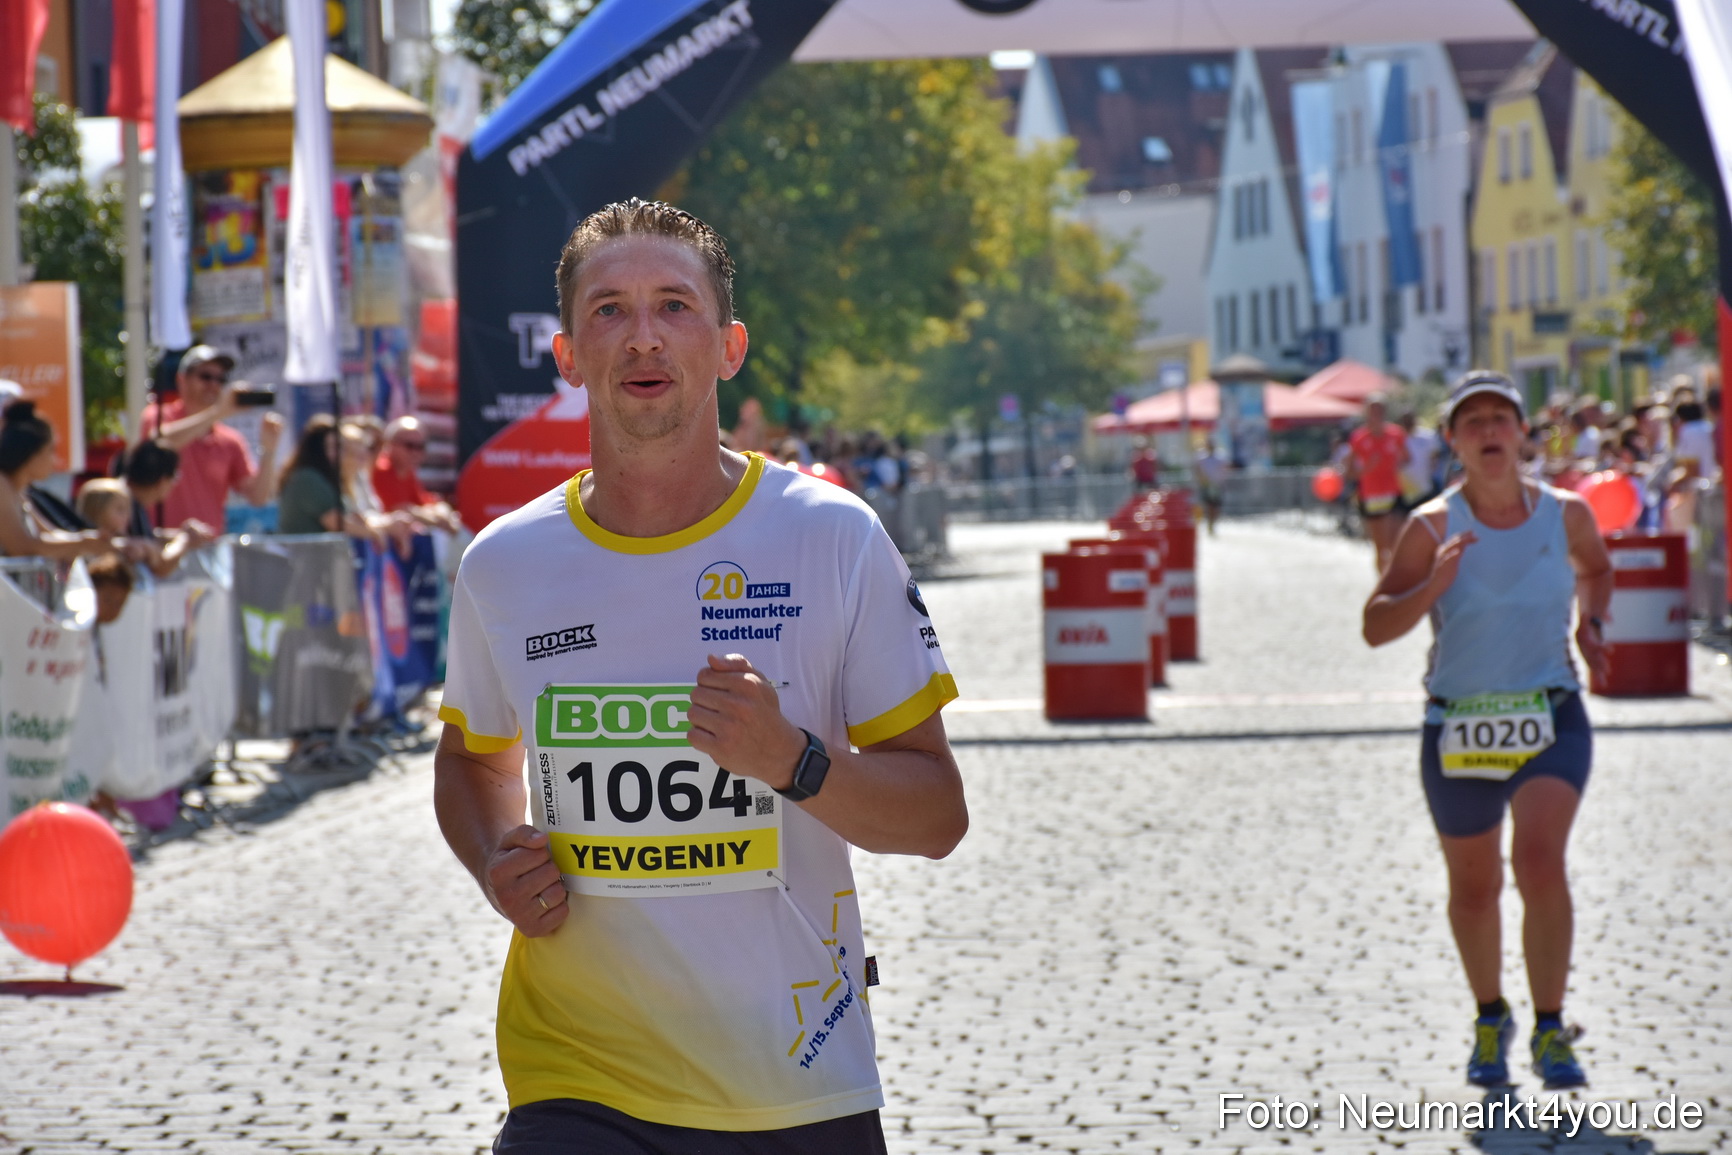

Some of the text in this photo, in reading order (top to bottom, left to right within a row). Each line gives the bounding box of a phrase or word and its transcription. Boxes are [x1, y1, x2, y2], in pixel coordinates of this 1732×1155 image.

[1590, 0, 1670, 48] ARTL
[508, 1, 752, 176] PARTL NEUMARKT
[702, 572, 787, 600] 20 JAHRE
[701, 603, 803, 620] Neumarkter
[526, 624, 597, 655] BOCK
[555, 647, 572, 655] smart
[572, 642, 598, 651] concepts
[701, 623, 783, 642] Stadtlauf
[552, 695, 692, 739] BOC
[1454, 717, 1542, 749] 1020
[566, 759, 753, 824] 1064
[569, 840, 752, 872] YEVGENIY
[800, 1031, 830, 1069] 14./15.
